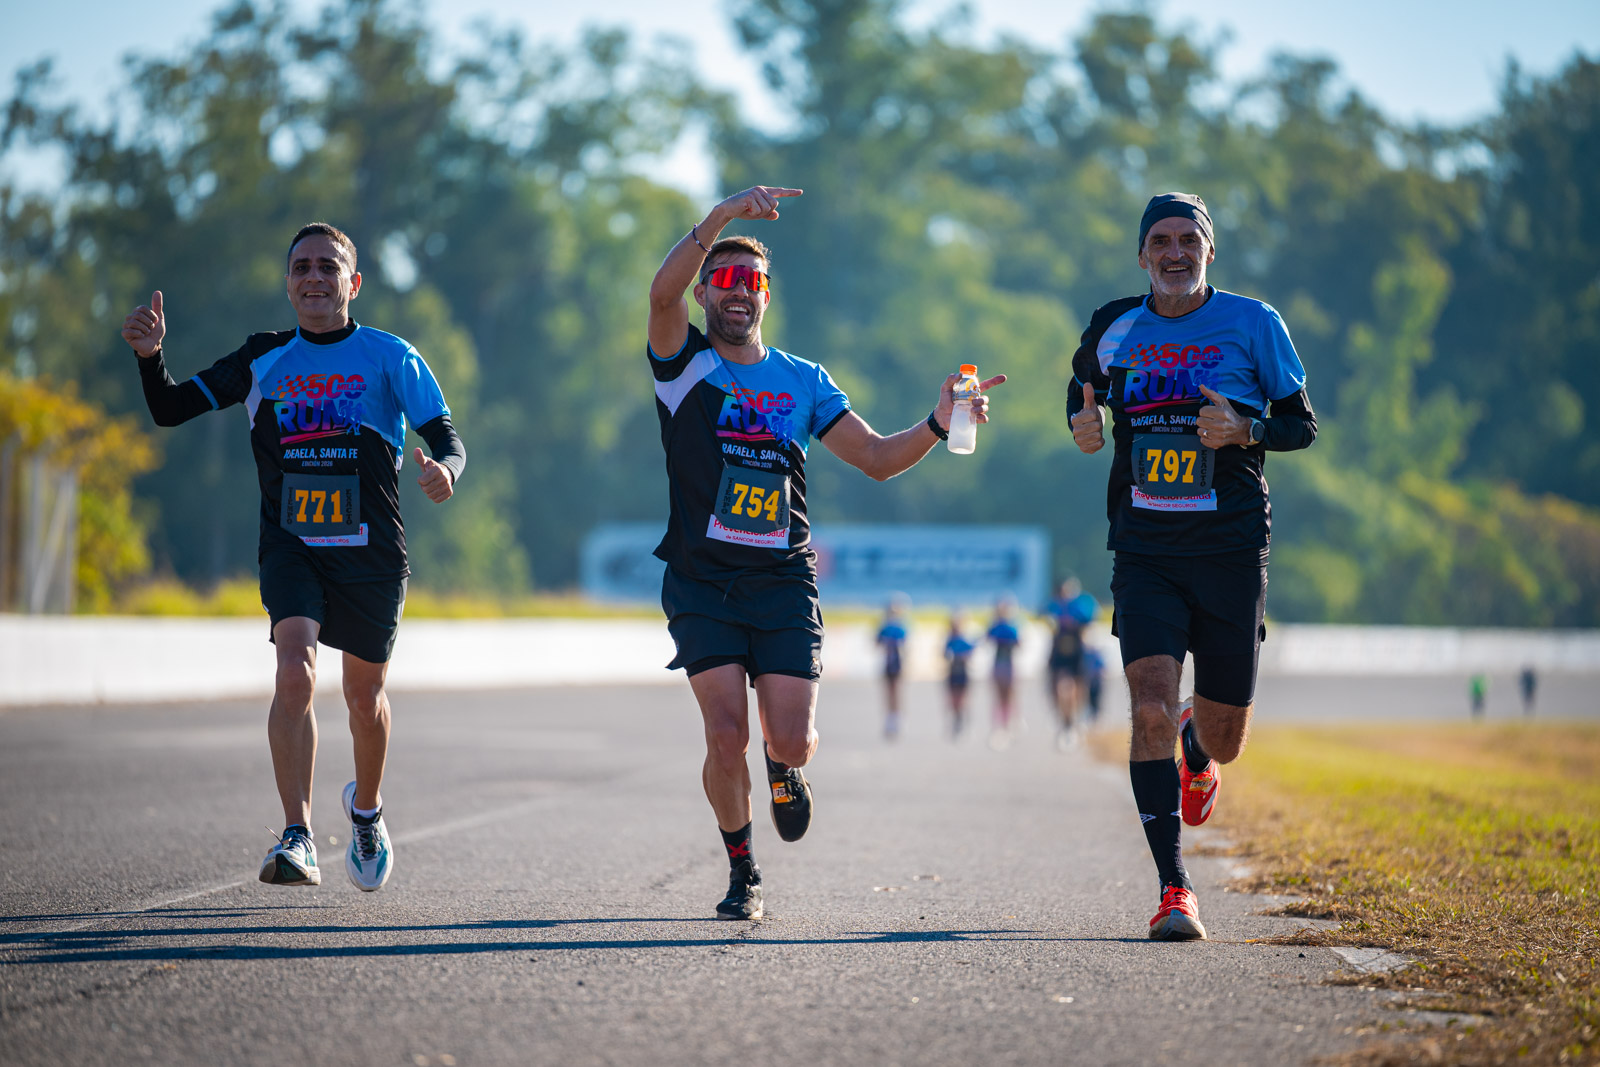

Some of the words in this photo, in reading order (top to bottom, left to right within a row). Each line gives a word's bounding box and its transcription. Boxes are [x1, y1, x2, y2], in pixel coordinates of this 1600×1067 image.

[1191, 353, 1224, 361] MILLAS
[336, 383, 367, 392] MILLAS
[767, 400, 797, 409] MILLAS
[1169, 415, 1197, 426] SANTA
[319, 447, 348, 459] SANTA
[348, 448, 358, 459] FE
[722, 442, 758, 460] RAFAELA,
[1146, 448, 1197, 484] 797
[295, 489, 344, 524] 771
[730, 482, 780, 522] 754
[732, 535, 754, 543] SANCOR
